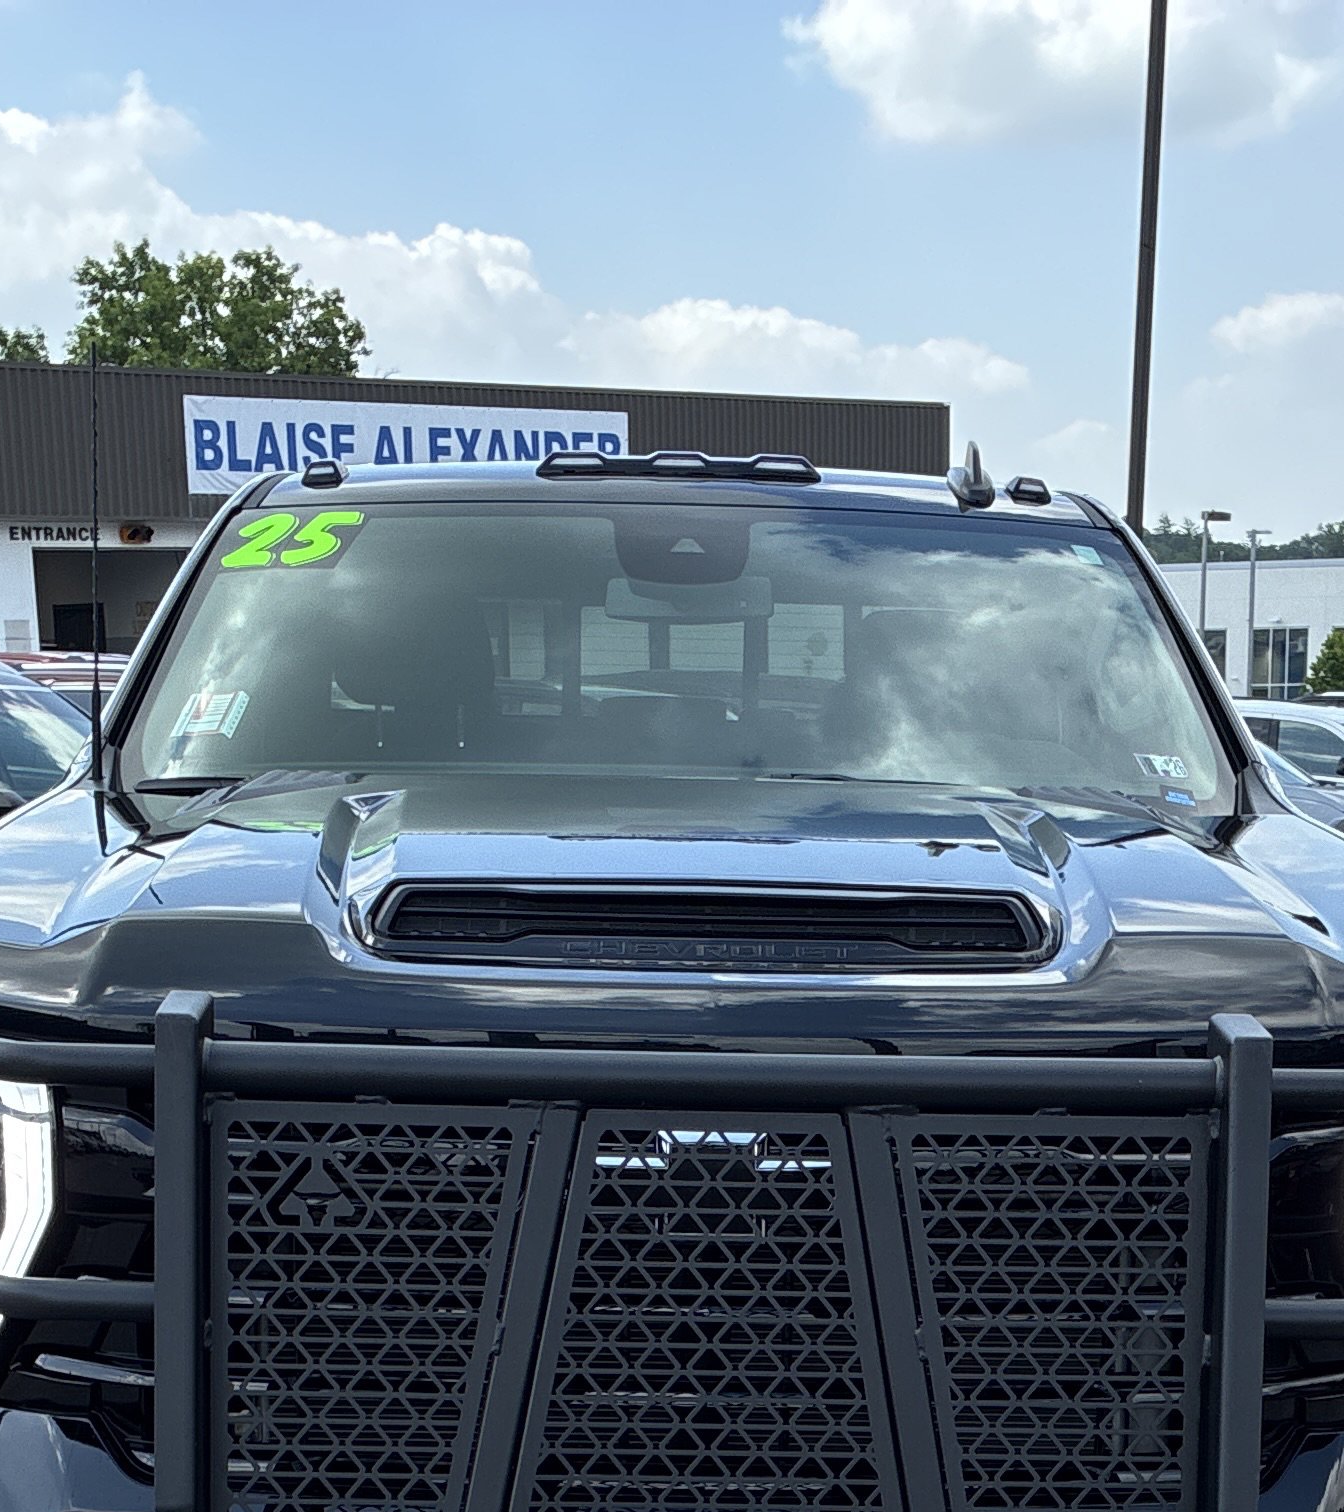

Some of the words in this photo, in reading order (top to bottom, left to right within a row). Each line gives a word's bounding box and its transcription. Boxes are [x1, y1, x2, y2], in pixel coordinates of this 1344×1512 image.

[193, 419, 355, 473] BLAISE
[9, 526, 100, 542] ENTRANCE
[221, 511, 365, 568] 25
[561, 940, 859, 960] CHEVROLET
